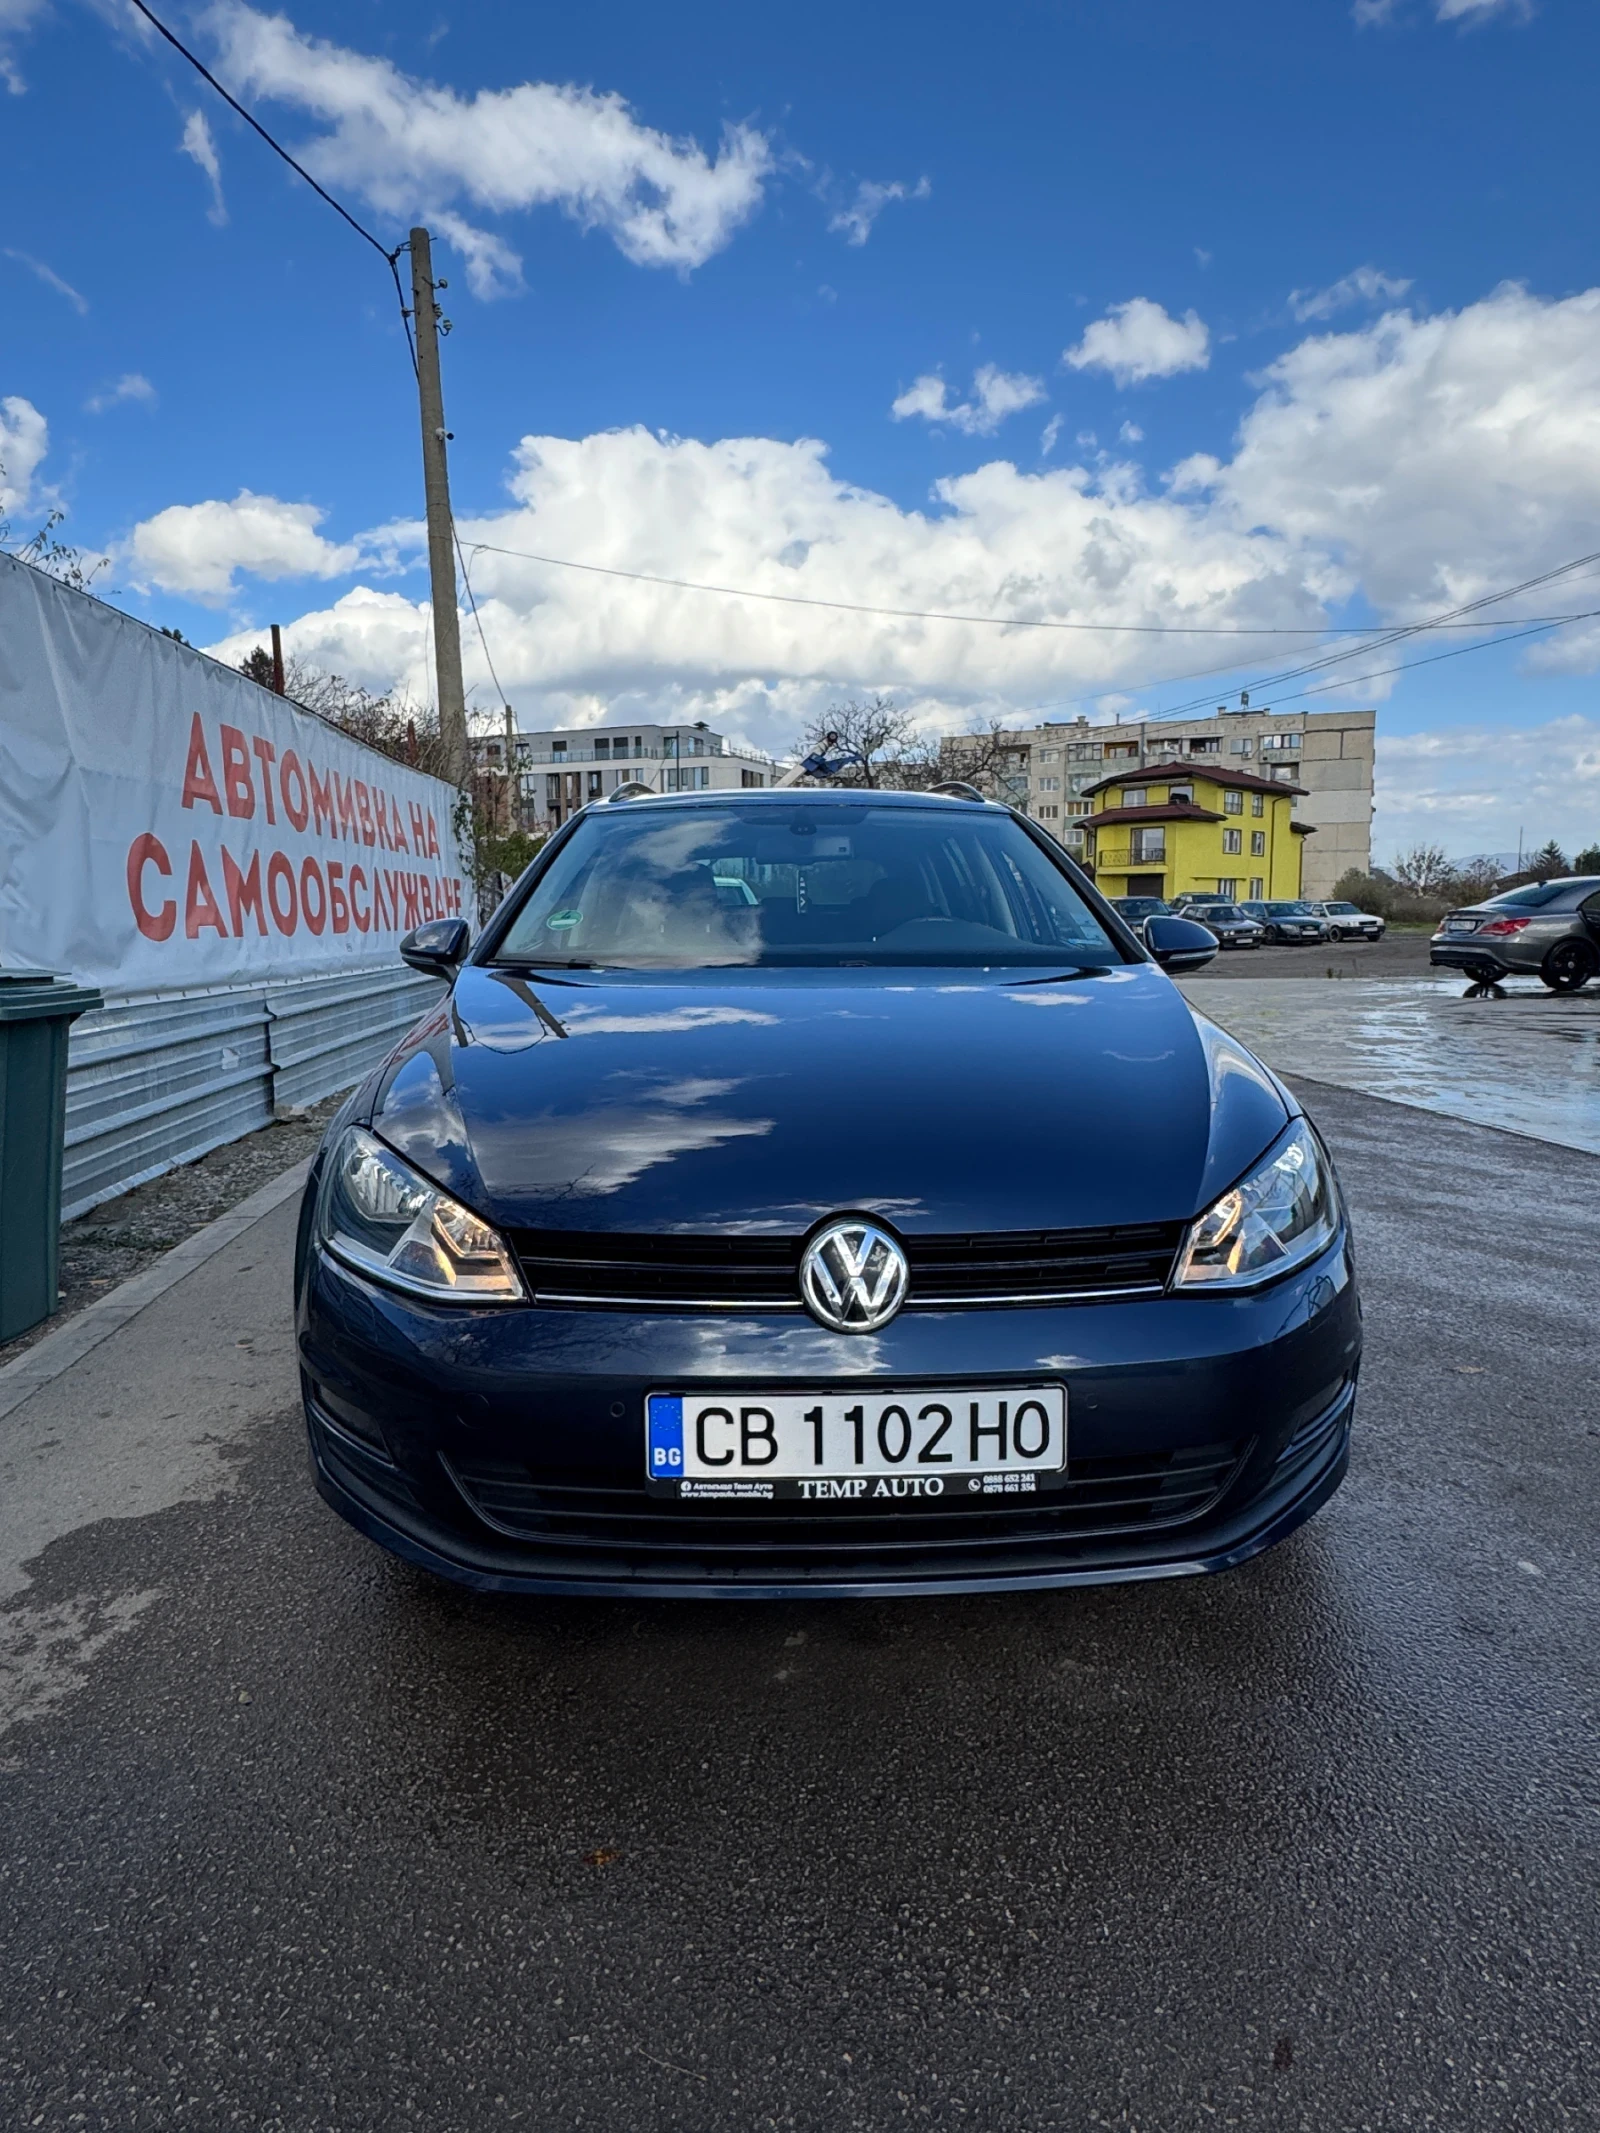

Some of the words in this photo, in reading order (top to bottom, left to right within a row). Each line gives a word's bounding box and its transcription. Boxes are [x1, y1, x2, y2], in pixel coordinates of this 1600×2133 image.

[181, 711, 409, 855] АВТОМИВКА
[408, 800, 441, 860] НА
[806, 1227, 904, 1328] VW
[653, 1447, 681, 1466] BG
[696, 1406, 778, 1466] CB
[803, 1404, 953, 1466] 1102
[969, 1400, 1050, 1462] HO
[798, 1480, 867, 1499] TEMP
[872, 1478, 944, 1497] AUTO
